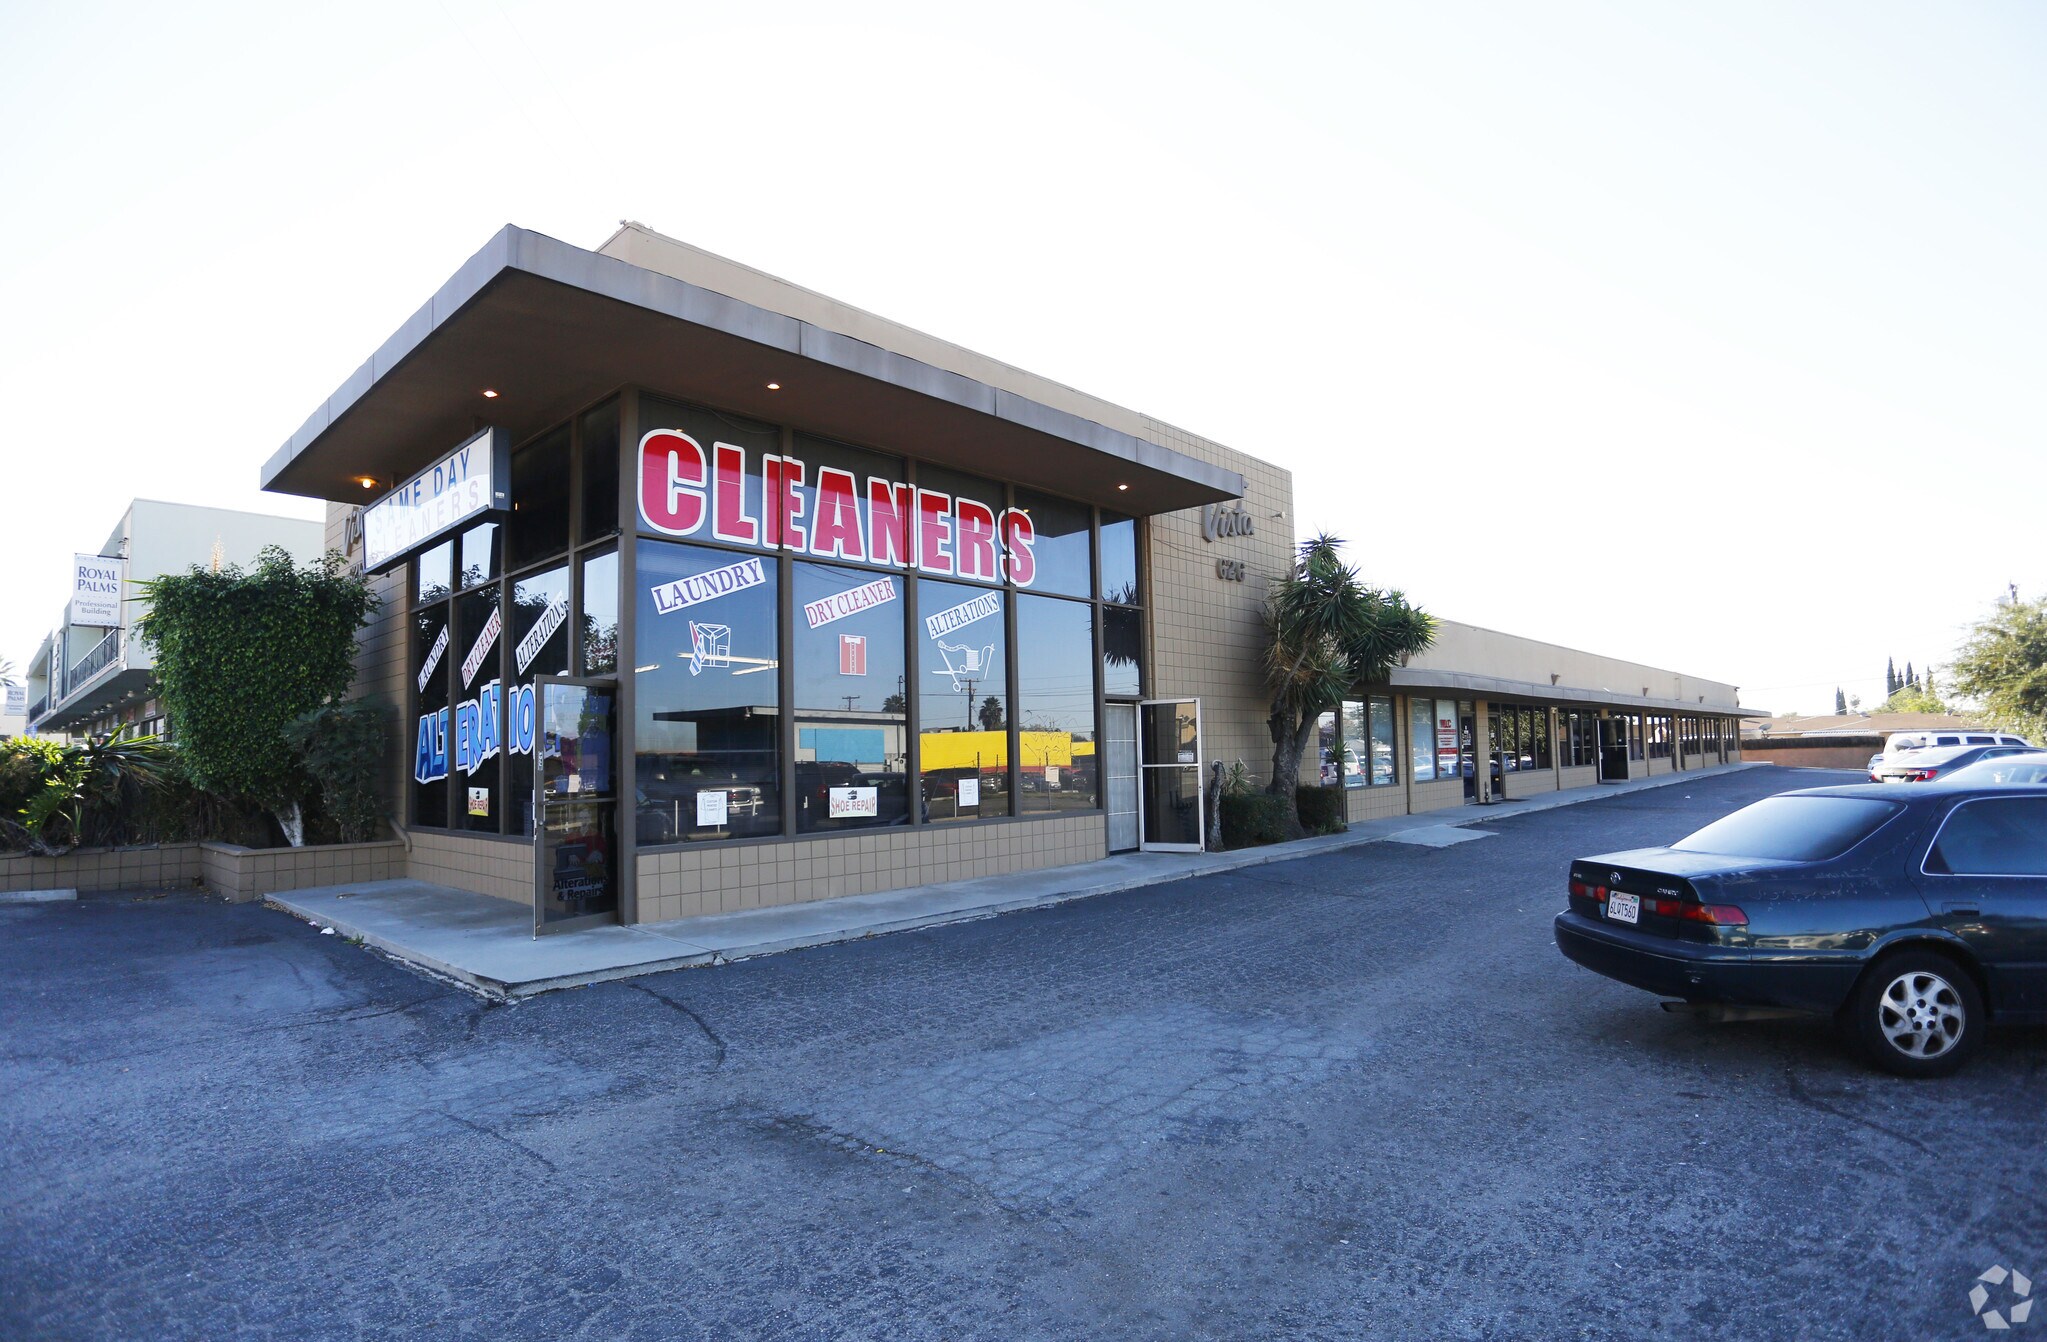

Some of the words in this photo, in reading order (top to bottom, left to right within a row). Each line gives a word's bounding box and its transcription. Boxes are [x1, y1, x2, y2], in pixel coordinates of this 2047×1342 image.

[433, 448, 470, 498] DAY
[638, 429, 1035, 587] CLEANERS
[78, 579, 117, 593] PALMS
[79, 566, 117, 580] ROYAL
[653, 560, 762, 611] LAUNDRY
[75, 600, 117, 608] Professional
[82, 607, 111, 615] Building
[806, 598, 835, 628] DRY
[838, 580, 896, 612] CLEANER
[929, 593, 999, 637] ALTERATIONS
[419, 629, 448, 689] LAUNDRY
[463, 655, 476, 686] DRY
[475, 612, 501, 666] CLEANER
[519, 597, 566, 672] ALTERATIONS
[415, 680, 536, 784] ALTERATIO
[831, 797, 850, 816] SHOE
[851, 797, 876, 815] REPAIR
